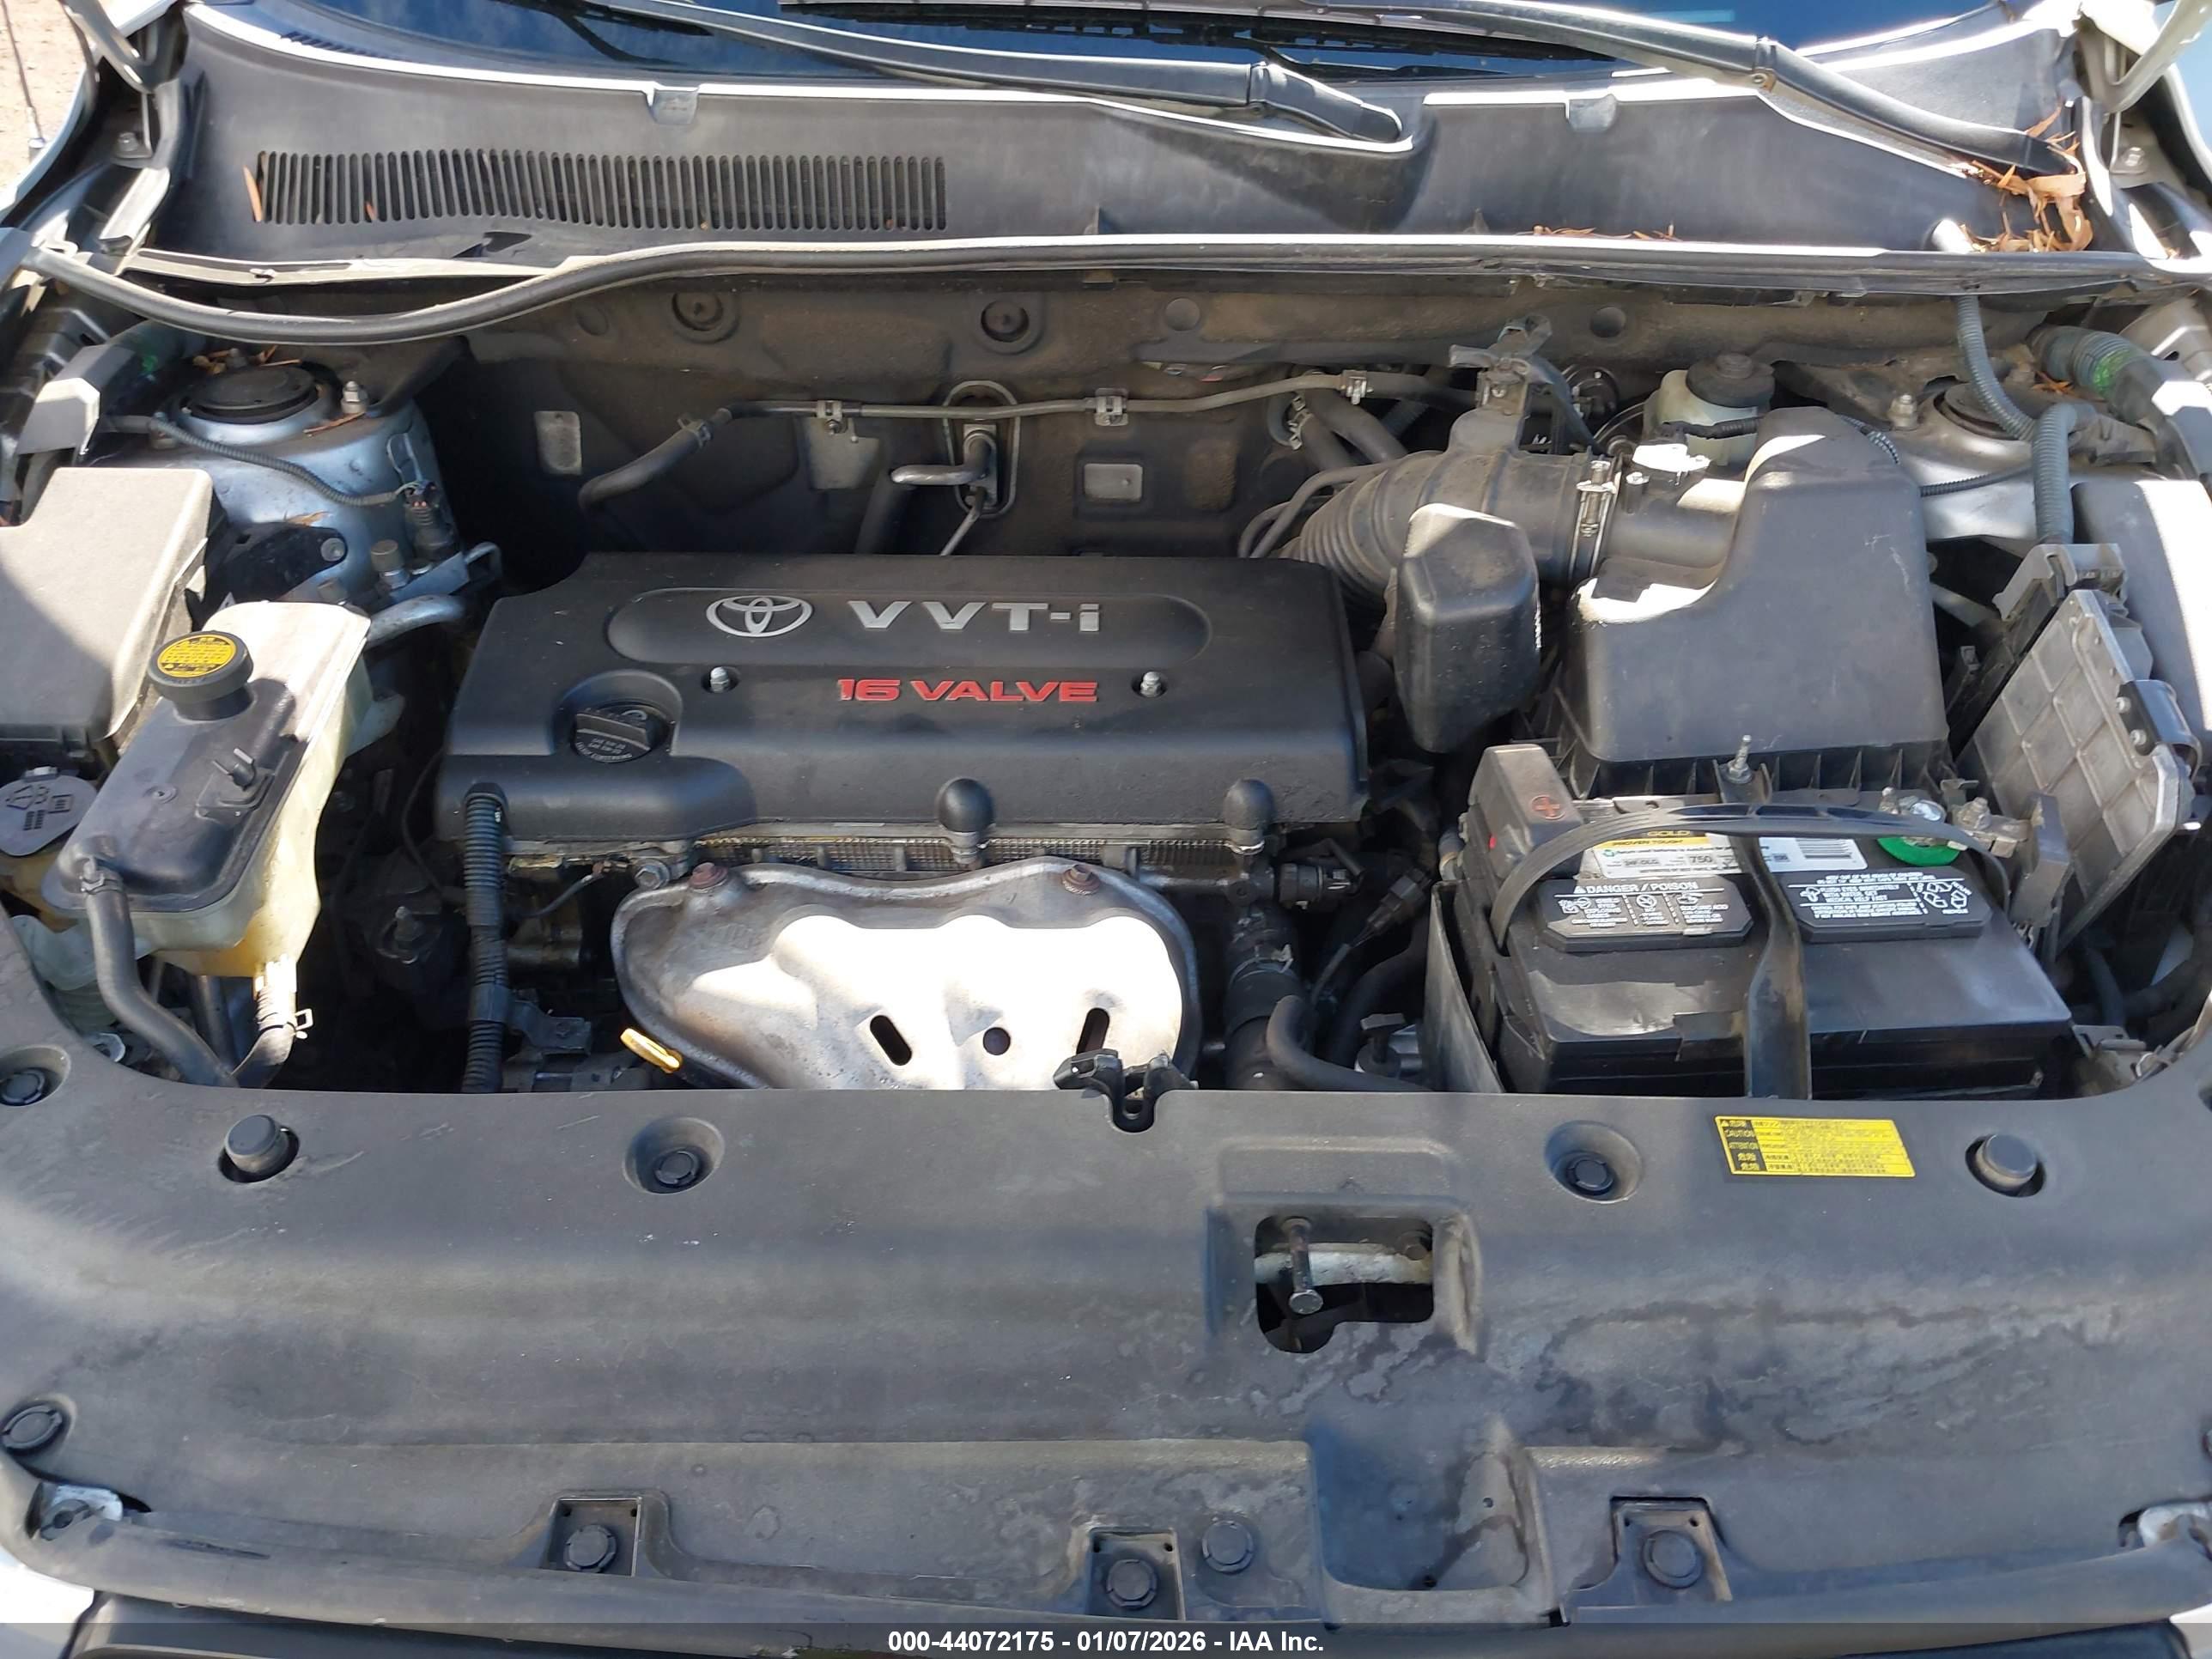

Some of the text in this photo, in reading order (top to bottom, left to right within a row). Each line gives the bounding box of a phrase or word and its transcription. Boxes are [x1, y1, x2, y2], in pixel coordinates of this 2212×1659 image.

[847, 600, 1100, 632] VVT-i
[836, 679, 1098, 702] 16 VALVE
[1589, 884, 1638, 894] DANGER
[1650, 881, 1698, 891] POISON
